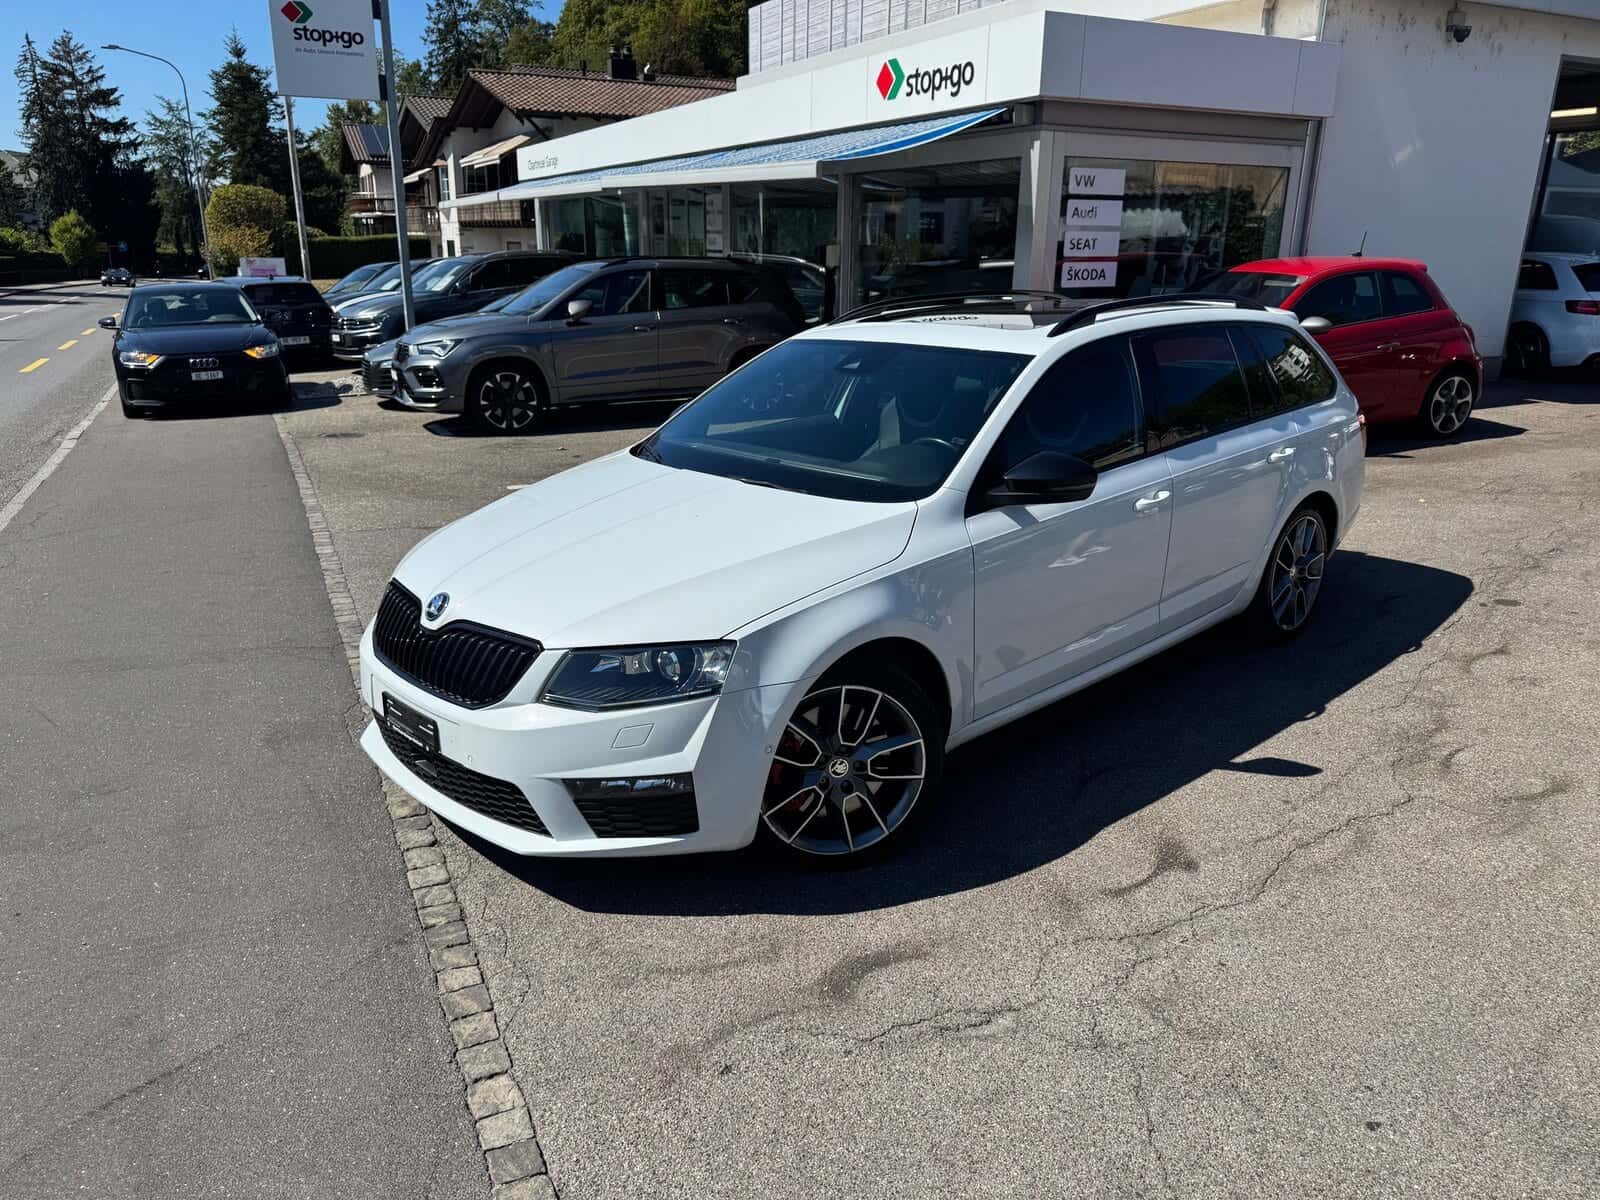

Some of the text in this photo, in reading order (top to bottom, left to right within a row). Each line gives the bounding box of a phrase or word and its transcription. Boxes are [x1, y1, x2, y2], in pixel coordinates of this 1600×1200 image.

[293, 25, 364, 49] stop+go
[906, 61, 975, 100] stop+go
[1074, 174, 1096, 187] VW
[1071, 206, 1098, 219] Audi
[1069, 238, 1098, 250] SEAT
[1066, 266, 1106, 281] ŠKODA
